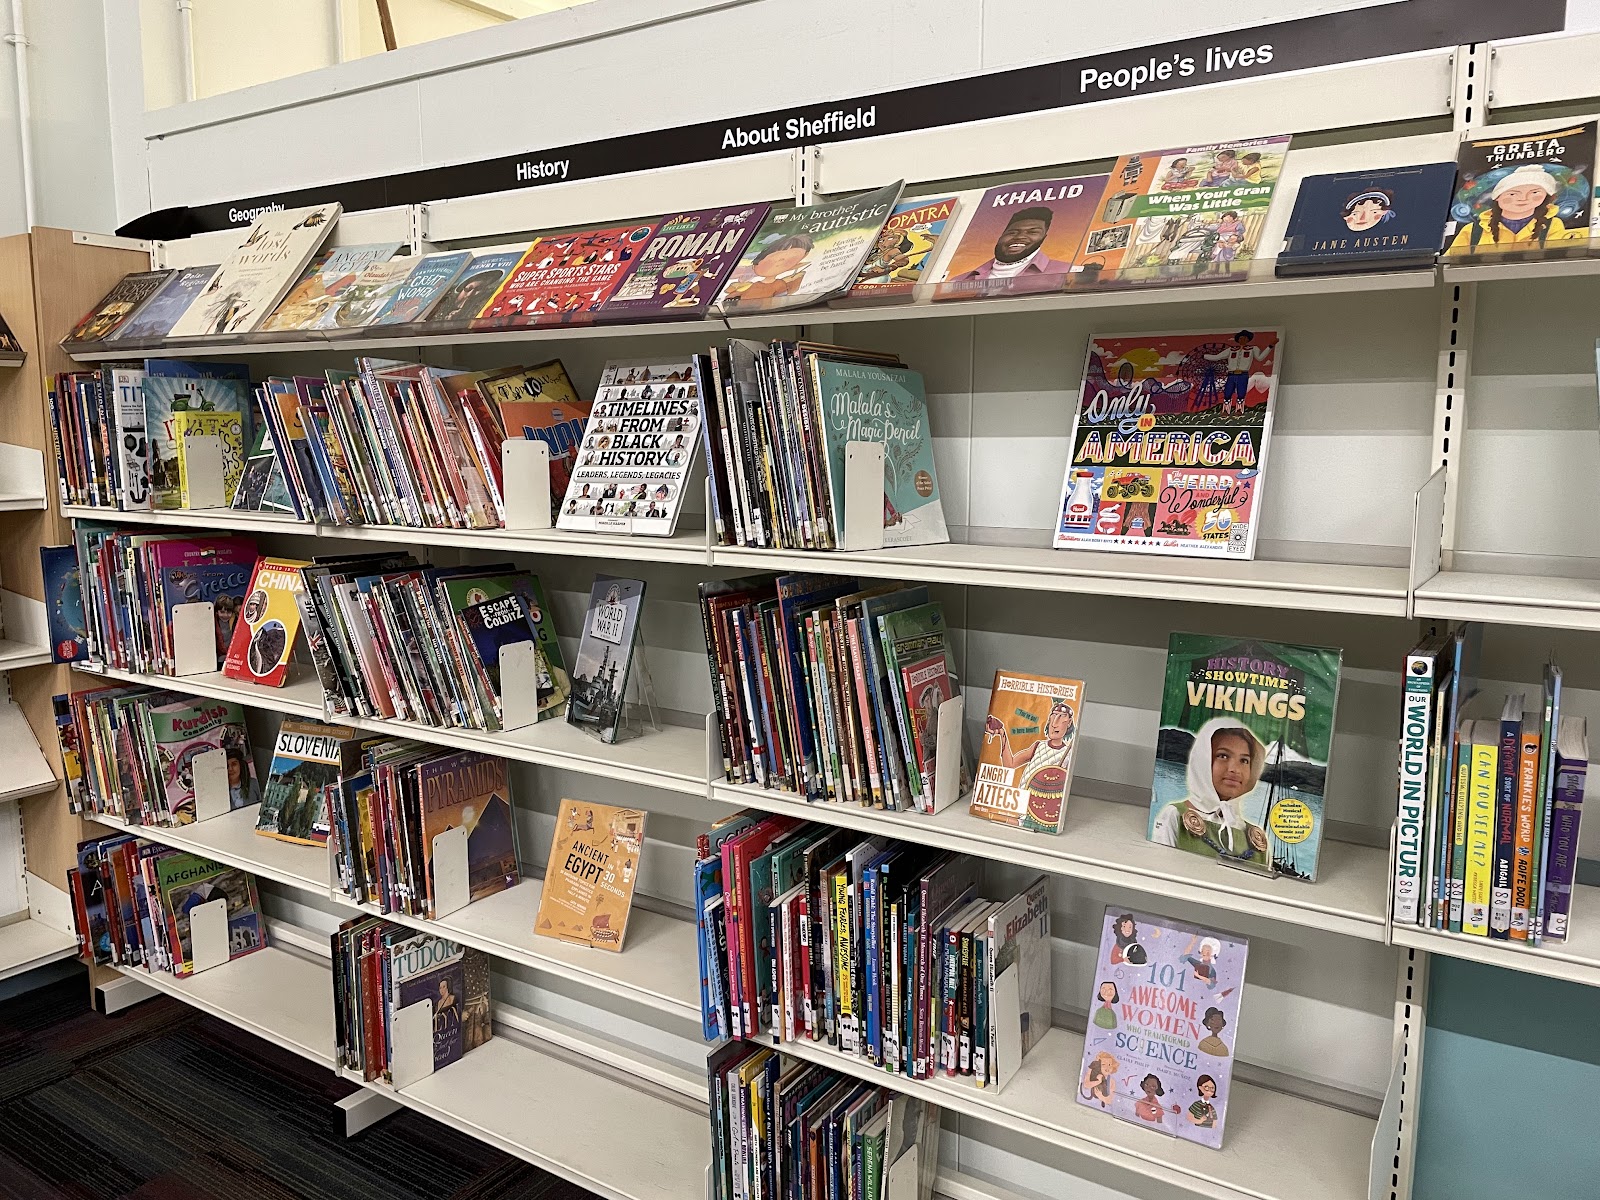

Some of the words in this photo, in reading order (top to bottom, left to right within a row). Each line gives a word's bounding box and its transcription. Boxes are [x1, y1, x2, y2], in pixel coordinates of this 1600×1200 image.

[1080, 54, 1195, 93] People's
[1205, 43, 1273, 74] lives
[721, 122, 780, 149] About
[785, 106, 876, 139] Sheffield
[1185, 144, 1217, 154] Family
[1219, 138, 1269, 151] Memories
[1486, 146, 1565, 163] THUNBERG
[1493, 138, 1560, 155] GRETA
[516, 159, 570, 181] History
[991, 183, 1085, 208] KHALID
[1148, 192, 1192, 206] When
[1193, 187, 1231, 202] Your
[1233, 184, 1271, 197] Gran
[1168, 200, 1200, 213] Was
[1201, 196, 1242, 208] Little
[789, 212, 808, 223] My
[810, 203, 860, 220] brother
[808, 203, 888, 234] autistic
[886, 203, 949, 231] OPATRA
[640, 228, 745, 261] ROMAN
[1312, 239, 1348, 251] JANE
[1354, 234, 1409, 248] AUSTEN
[239, 245, 291, 265] words
[332, 247, 391, 264] ANCIENT
[410, 274, 447, 287] GREAT
[514, 270, 550, 283] SUPER
[549, 266, 587, 280] SPORTS
[586, 263, 621, 277] STARS
[524, 280, 539, 288] ARE
[539, 277, 576, 286] CHANGING
[577, 275, 592, 283] THE
[592, 273, 613, 282] GAME
[397, 287, 438, 301] WOMEN
[835, 368, 866, 379] MALALA
[867, 371, 906, 383] YOUSAFZAI
[607, 400, 690, 417] TIMELINES
[831, 389, 896, 421] Malala's
[1085, 384, 1156, 434] Only
[96, 382, 105, 421] STUDENT
[101, 423, 110, 457] ATLAS
[618, 418, 665, 433] FROM
[801, 403, 810, 431] DESIGN
[1139, 417, 1153, 427] IN
[611, 434, 664, 449] BLACK
[843, 414, 884, 442] Magic
[884, 420, 921, 446] Pencil
[53, 426, 62, 461] HISTORY
[1074, 430, 1257, 467] AMERICA
[598, 451, 667, 467] HISTORY
[576, 471, 609, 479] LEADERS,
[610, 471, 645, 479] LEGENDS,
[645, 471, 682, 480] LEGACIES
[1165, 472, 1233, 490] WEIRD
[1160, 486, 1248, 514] Wonderful
[1201, 508, 1232, 532] 50
[1202, 532, 1229, 540] STATES
[183, 571, 247, 600] Greece
[305, 599, 316, 620] THE
[478, 595, 519, 619] ESCAPE
[483, 607, 525, 630] COLDITZ
[598, 605, 623, 624] WORLD
[597, 620, 611, 633] WAR
[611, 623, 619, 637] II
[1207, 657, 1290, 679] HISTORY
[708, 654, 720, 692] WOMEN'S
[714, 692, 722, 712] WAR
[1001, 678, 1035, 693] HORRIBLE
[1036, 683, 1075, 698] HISTORIES
[1205, 670, 1289, 690] SHOWTIME
[1186, 681, 1306, 722] VIKINGS
[1408, 695, 1426, 703] OUR
[172, 705, 228, 732] Kurdish
[182, 718, 222, 737] Community
[1401, 705, 1426, 775] WORLD
[866, 740, 876, 774] MONAGHAN
[1478, 751, 1492, 778] CAN
[1501, 737, 1516, 776] Different
[425, 766, 444, 776] THE
[980, 765, 1010, 782] ANGRY
[425, 758, 504, 813] PYRAMIDS
[1402, 780, 1422, 803] IN
[1503, 776, 1512, 793] SORT
[1521, 760, 1535, 812] FRANKIE'S
[1566, 774, 1580, 797] SHOW
[976, 785, 1021, 811] AZTECS
[1476, 784, 1490, 809] YOU
[1503, 793, 1511, 802] OF
[1474, 814, 1488, 835] SEE
[1500, 803, 1512, 845] NORMAL
[1520, 814, 1532, 842] WORLD
[1561, 815, 1574, 831] WHO
[572, 840, 609, 865] ANCIENT
[1472, 841, 1486, 867] ME?
[1558, 836, 1571, 851] YOU
[564, 853, 604, 884] EGYPT
[1517, 859, 1528, 884] AOIFE
[1555, 853, 1568, 868] ARE
[602, 870, 615, 884] 30
[1499, 858, 1508, 888] ABIGAIL
[600, 882, 625, 898] SECONDS
[1026, 885, 1045, 904] Queen
[1004, 897, 1049, 940] Elizabeth
[1039, 913, 1049, 939] II
[839, 936, 849, 971] AWESOME
[1147, 963, 1188, 992] 101
[1128, 985, 1199, 1020] AWESOME
[1121, 1003, 1201, 1040] WOMEN
[1126, 1024, 1142, 1035] WHO
[1143, 1027, 1191, 1048] TRANSFORMED
[1115, 1032, 1198, 1071] SCIENCE
